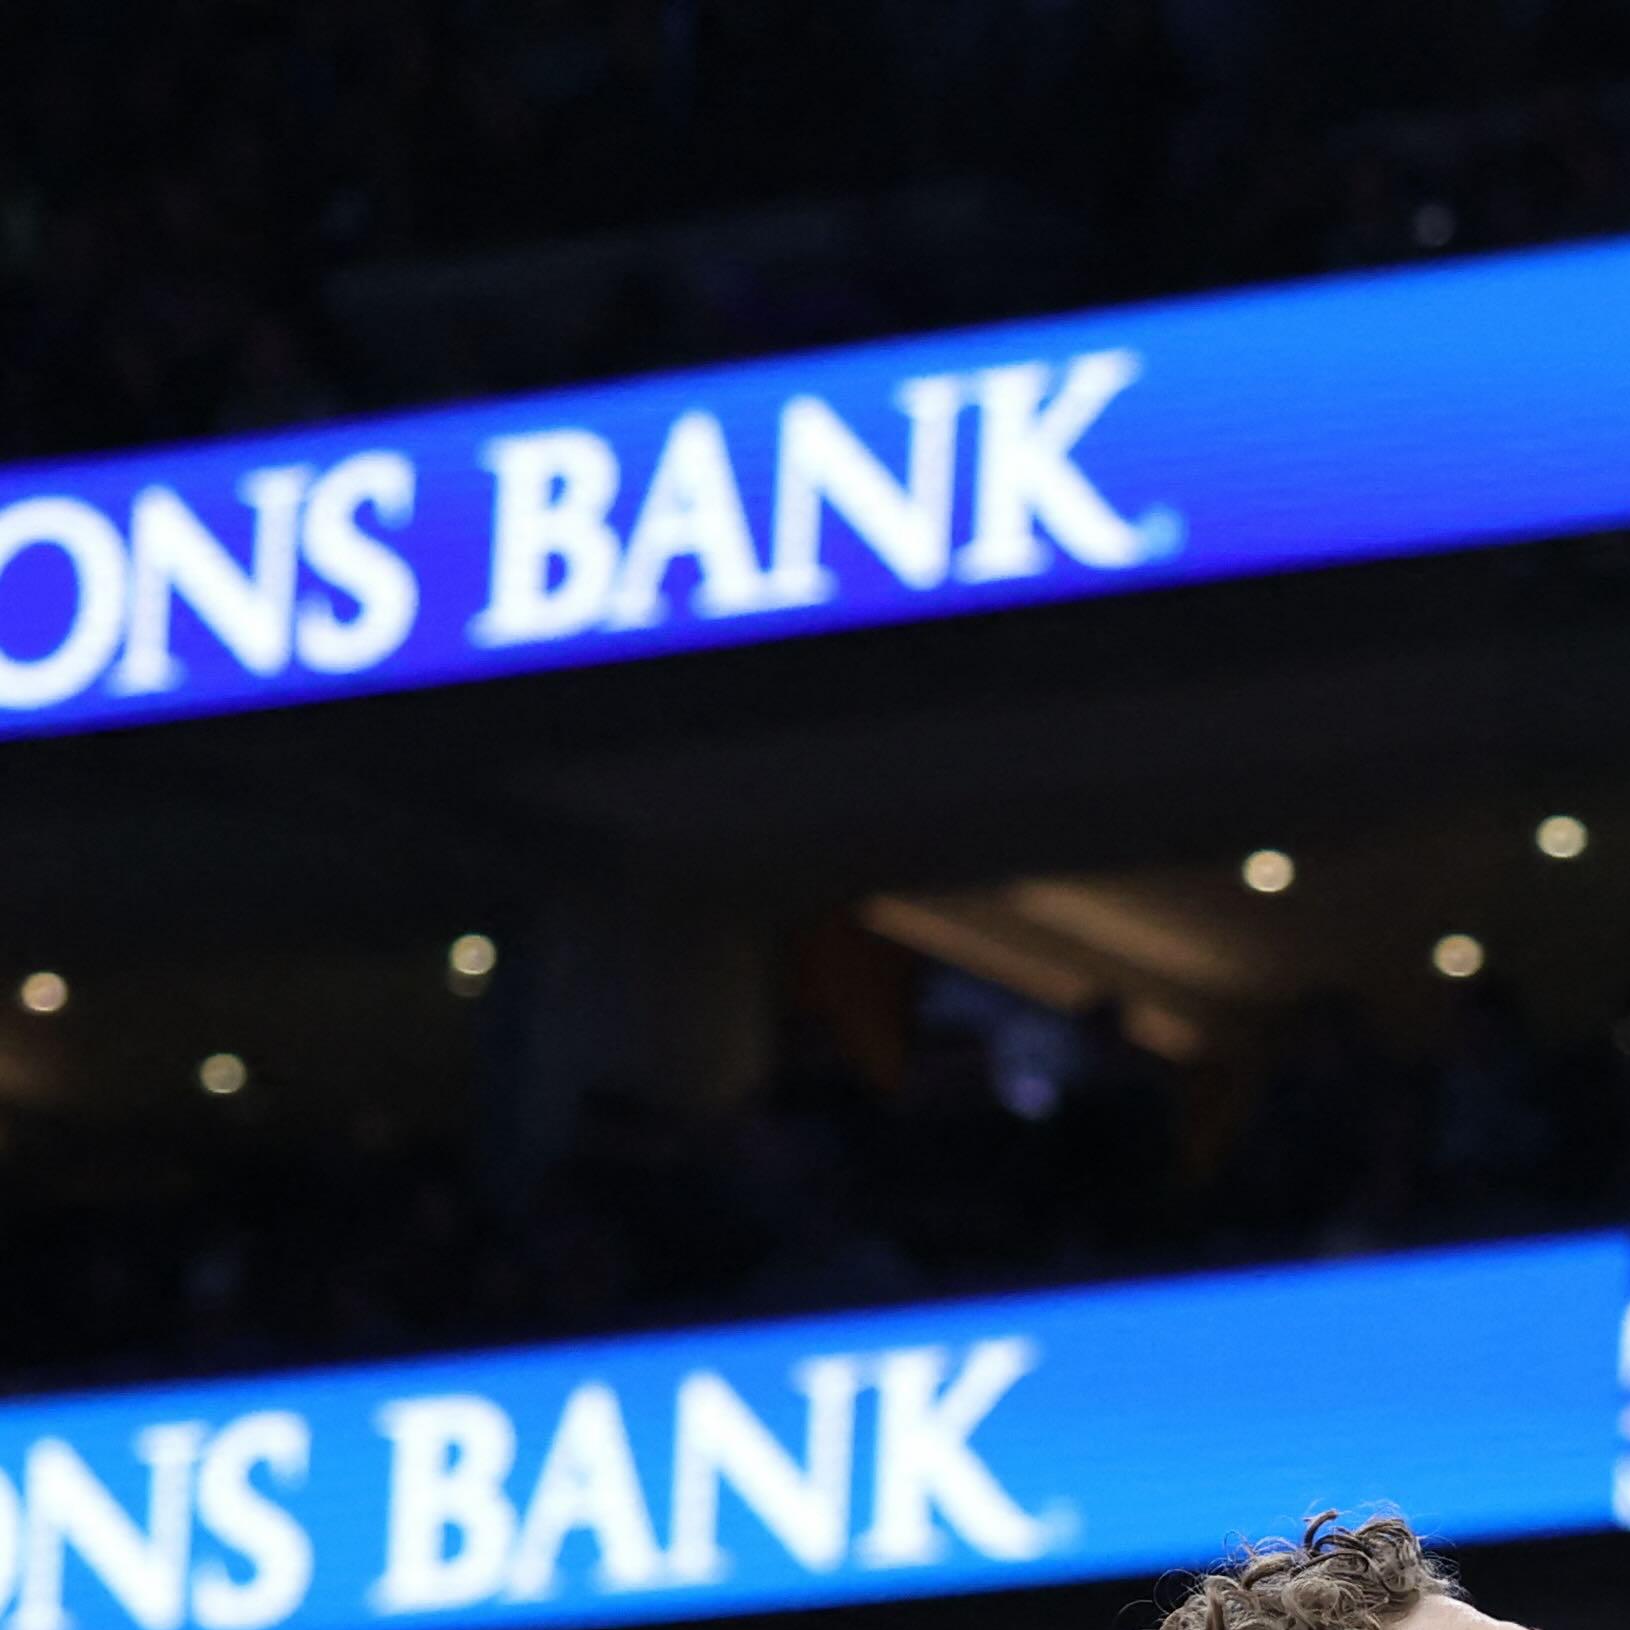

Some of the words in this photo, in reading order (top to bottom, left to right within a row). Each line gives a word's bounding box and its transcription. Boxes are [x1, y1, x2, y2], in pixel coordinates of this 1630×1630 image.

[0, 449, 420, 710] ONS
[465, 346, 1144, 650] BANK
[370, 1335, 1040, 1615] BANK
